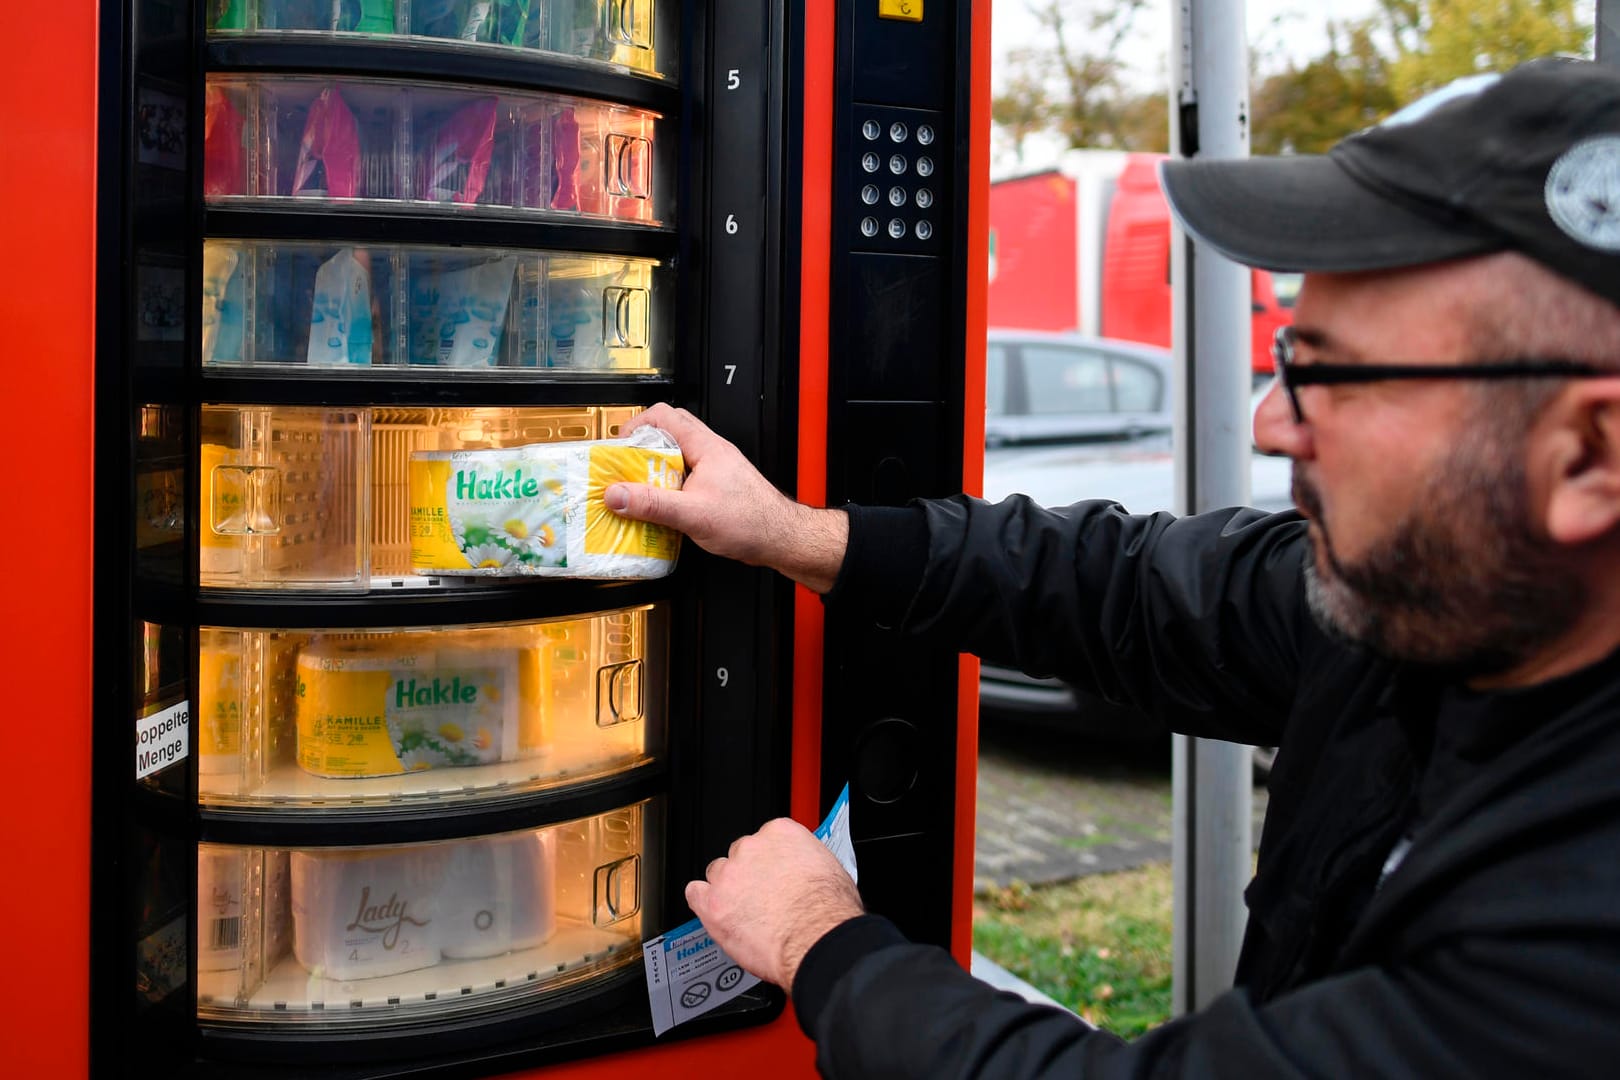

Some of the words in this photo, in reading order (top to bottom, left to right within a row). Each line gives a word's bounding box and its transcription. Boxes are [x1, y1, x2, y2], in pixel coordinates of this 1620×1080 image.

[727, 69, 740, 90] 5
[725, 214, 738, 234] 6
[724, 365, 737, 385] 7
[456, 468, 539, 500] Hakle
[717, 667, 729, 687] 9
[396, 676, 477, 708] Hakle
[327, 714, 381, 725] KAMILLE
[139, 739, 183, 772] Menge
[346, 886, 432, 950] Lady
[723, 972, 737, 985] 10
